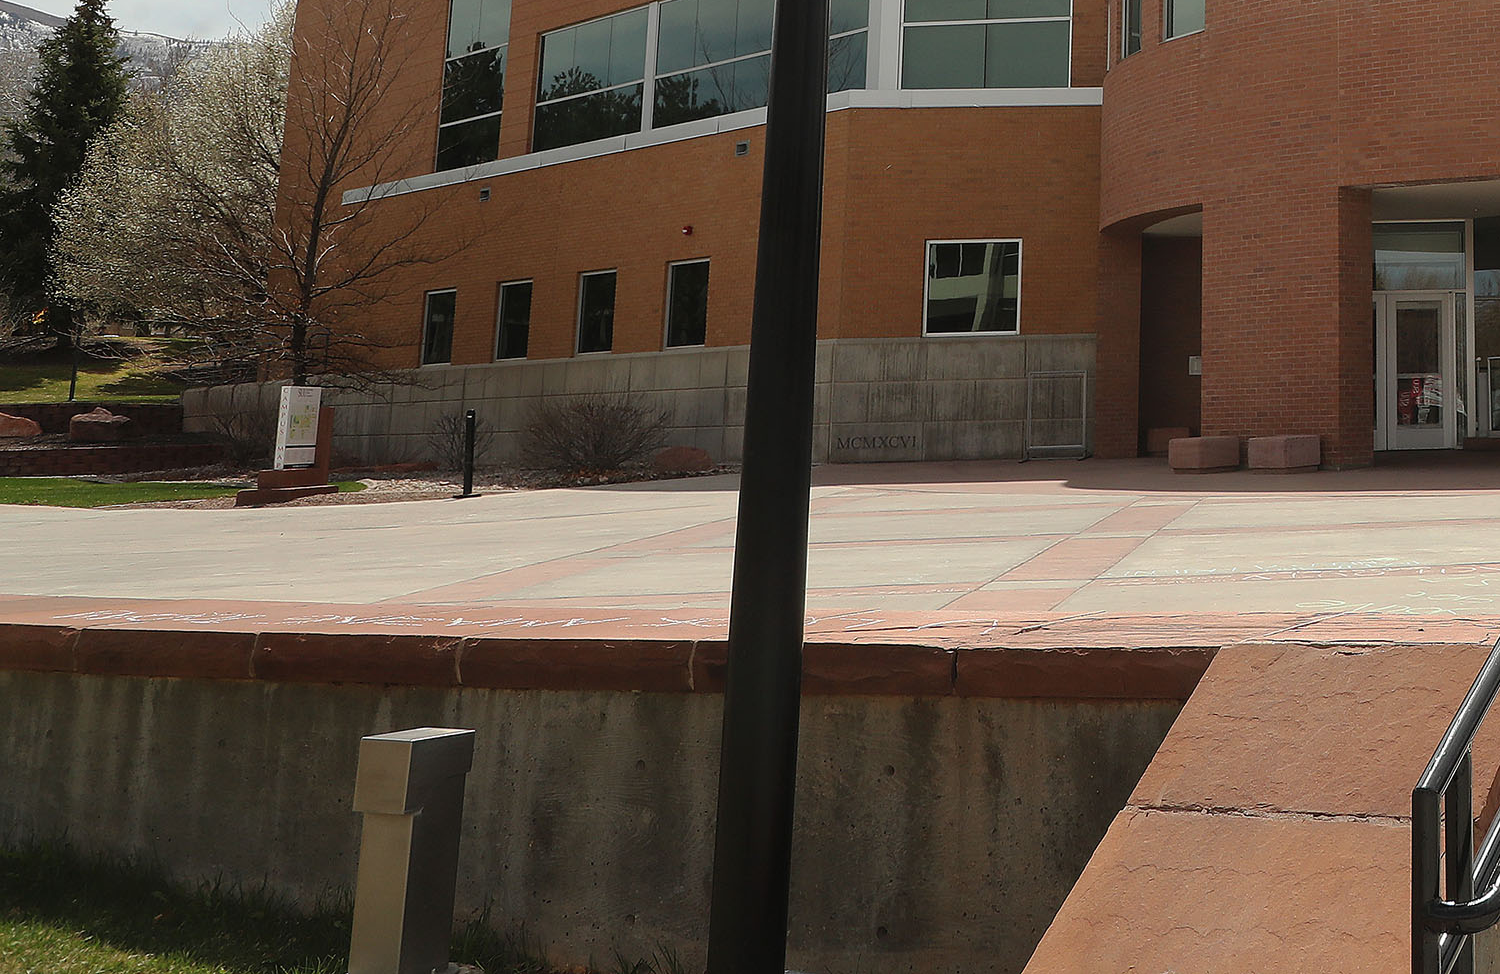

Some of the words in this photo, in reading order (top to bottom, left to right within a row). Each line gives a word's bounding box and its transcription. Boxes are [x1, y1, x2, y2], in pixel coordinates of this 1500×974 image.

[279, 388, 289, 435] CAMPUS
[837, 435, 917, 450] MCMXCVI
[276, 446, 284, 469] MAP
